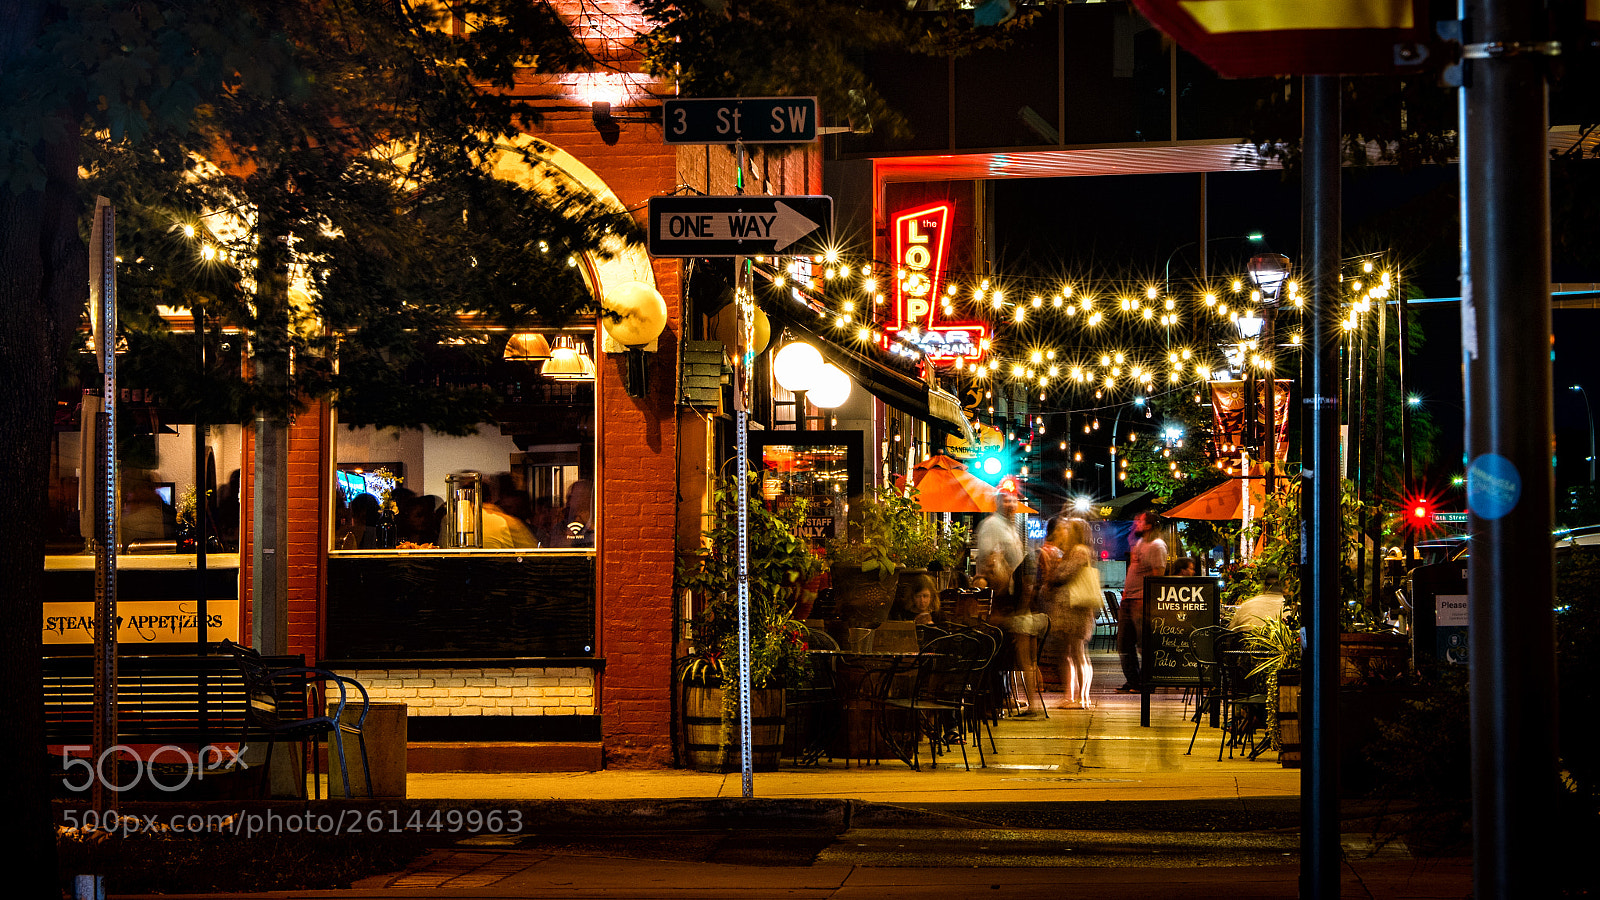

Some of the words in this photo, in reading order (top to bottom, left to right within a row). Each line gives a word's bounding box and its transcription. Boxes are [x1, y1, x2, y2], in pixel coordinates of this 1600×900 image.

[672, 108, 687, 135] 3
[716, 107, 742, 134] St
[770, 106, 807, 134] SW
[669, 215, 714, 238] ONE
[728, 215, 777, 238] WAY
[922, 219, 937, 228] the
[905, 219, 931, 323] LOOP
[806, 518, 832, 527] STAFF
[1156, 586, 1205, 602] JACK
[1157, 602, 1181, 611] LIVES
[1441, 601, 1467, 609] Please
[1151, 616, 1185, 635] Please
[1153, 649, 1177, 668] Patio
